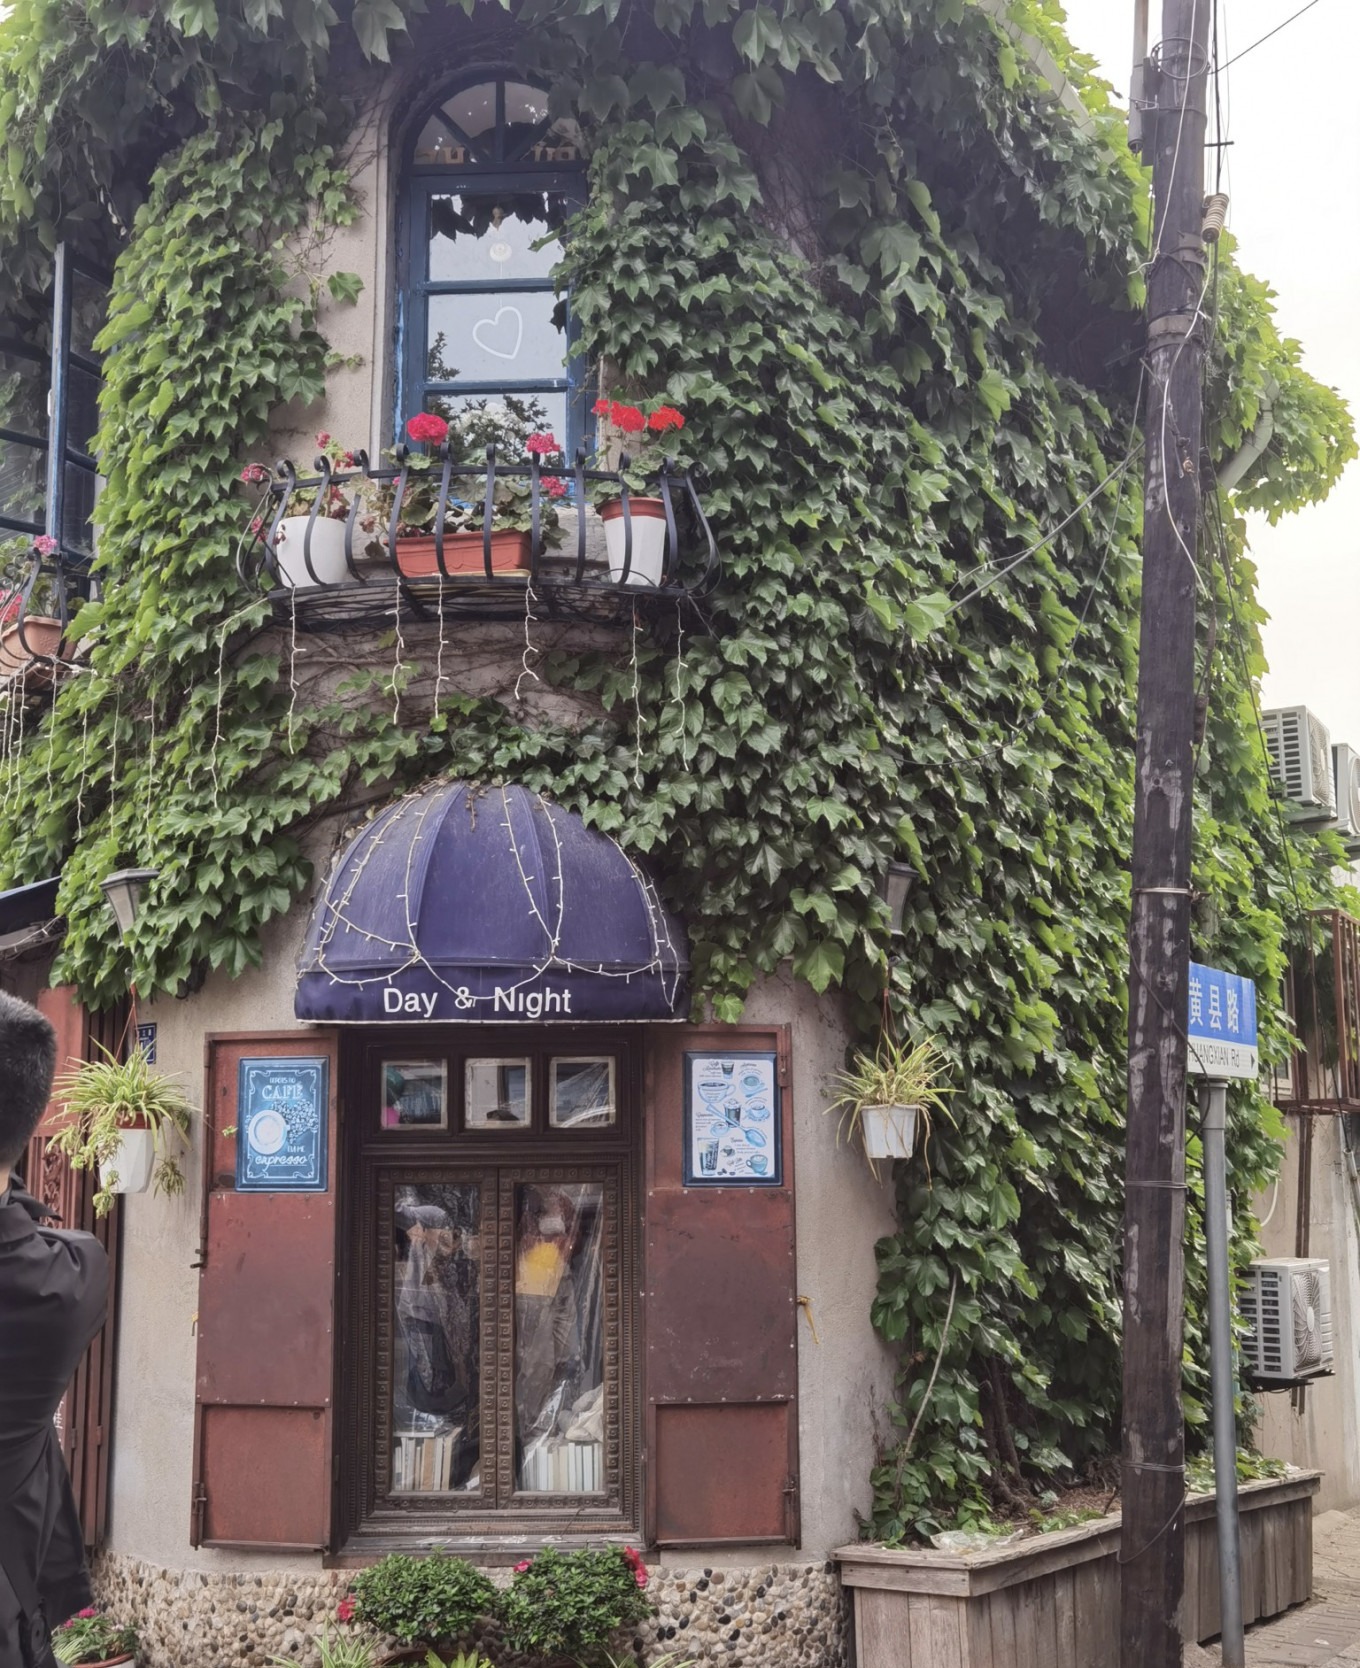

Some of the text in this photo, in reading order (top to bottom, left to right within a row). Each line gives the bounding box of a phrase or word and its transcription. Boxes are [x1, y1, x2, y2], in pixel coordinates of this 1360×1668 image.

[383, 986, 572, 1018] Day & Night
[1188, 977, 1239, 1034] 黄县路
[1231, 1048, 1240, 1069] Rd
